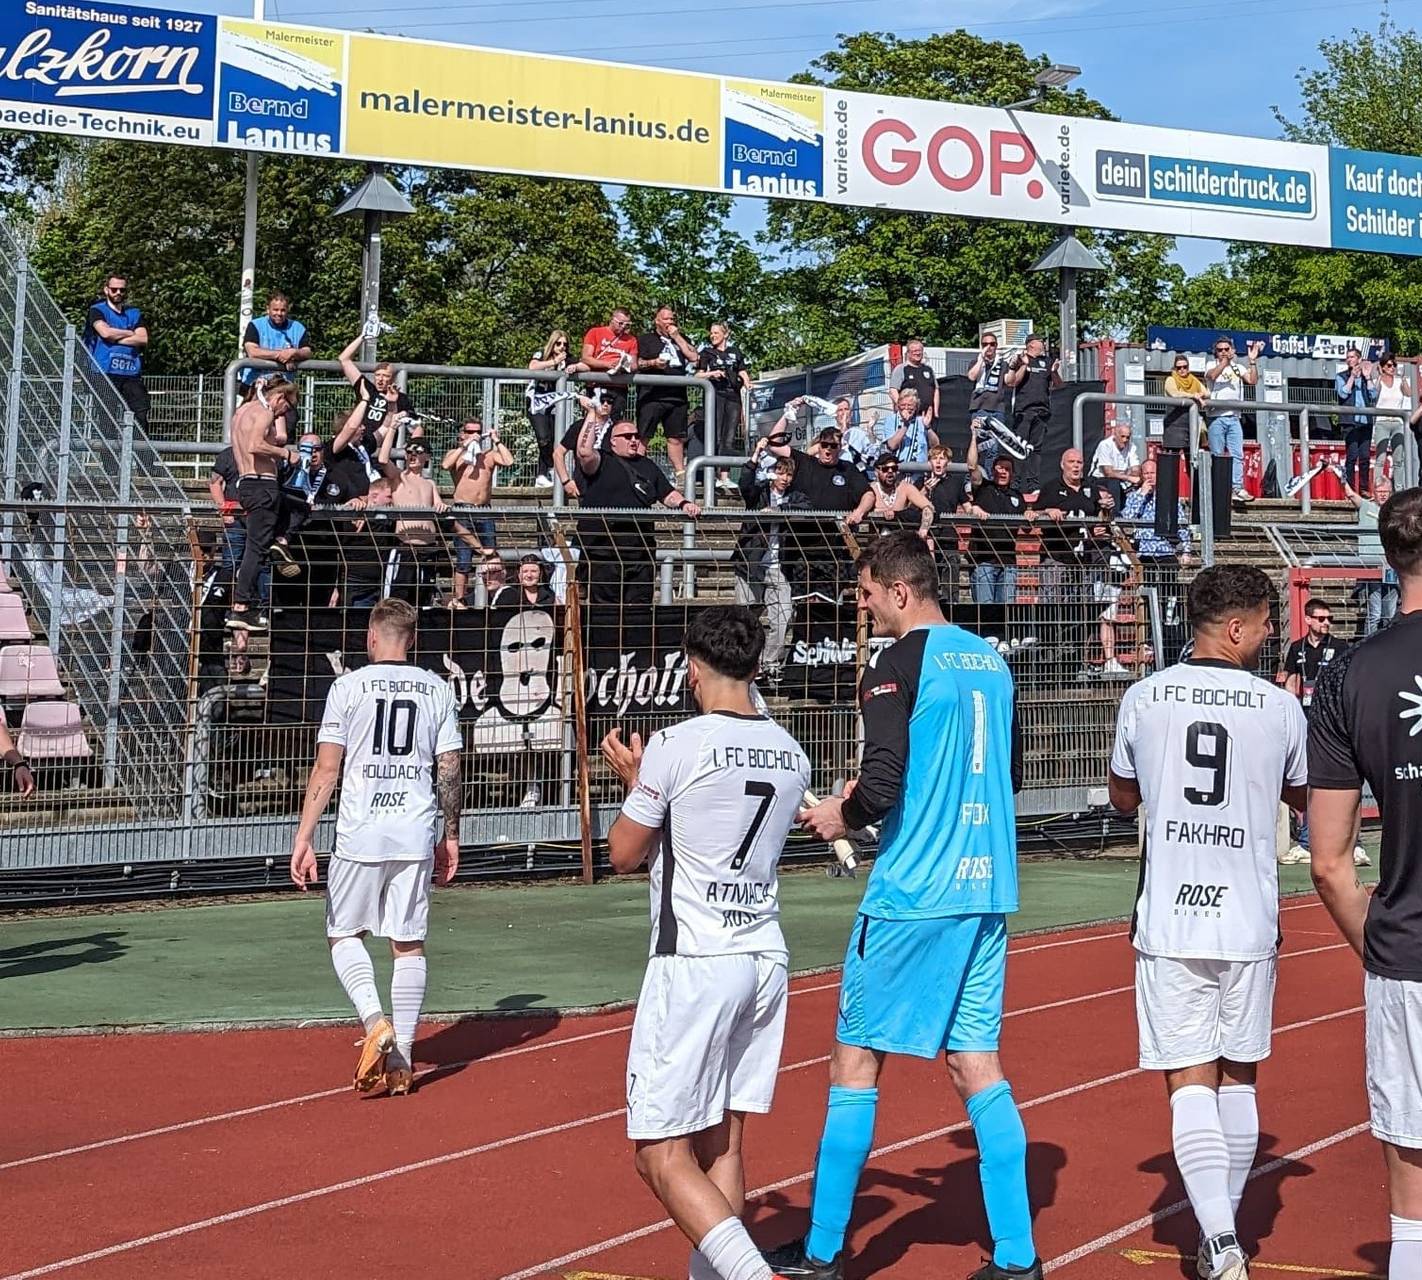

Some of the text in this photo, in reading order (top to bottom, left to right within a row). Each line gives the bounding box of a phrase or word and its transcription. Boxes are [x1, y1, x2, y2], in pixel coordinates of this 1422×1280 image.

[25, 1, 203, 34] Sanitätshaus seit 1927
[266, 30, 334, 47] Malermeister
[229, 91, 308, 119] Bernd
[760, 88, 816, 103] Malermeister
[0, 109, 200, 140] aedie-Technik.eu
[360, 89, 710, 143] malermeister-lanius.de
[228, 120, 332, 152] Lanius
[834, 100, 848, 194] variete.de
[733, 144, 797, 167] Bernd
[861, 118, 1044, 199] GOP.
[1056, 124, 1071, 215] variete.de
[1101, 151, 1142, 187] dein
[733, 169, 816, 196] Lanius
[1153, 159, 1307, 204] schilderdruck.de
[1345, 164, 1384, 193] Kauf
[1346, 206, 1416, 238] Schilder
[1272, 334, 1309, 354] Gaffel
[371, 680, 386, 692] FC
[389, 680, 436, 697] BOCHOLT
[1164, 685, 1186, 702] FC
[1192, 688, 1266, 709] BOCHOLT
[372, 698, 418, 757] 10
[972, 690, 986, 774] 1
[362, 764, 422, 780] HOLLDACK
[726, 747, 744, 767] FC
[748, 748, 801, 773] BOCHOLT
[1184, 720, 1232, 809] 9
[371, 792, 408, 807] ROSE
[962, 802, 990, 825] FOX
[730, 781, 778, 870] 7
[1166, 821, 1245, 849] FAKHRO
[706, 881, 775, 905] ATMACA
[1175, 883, 1228, 907] ROSE
